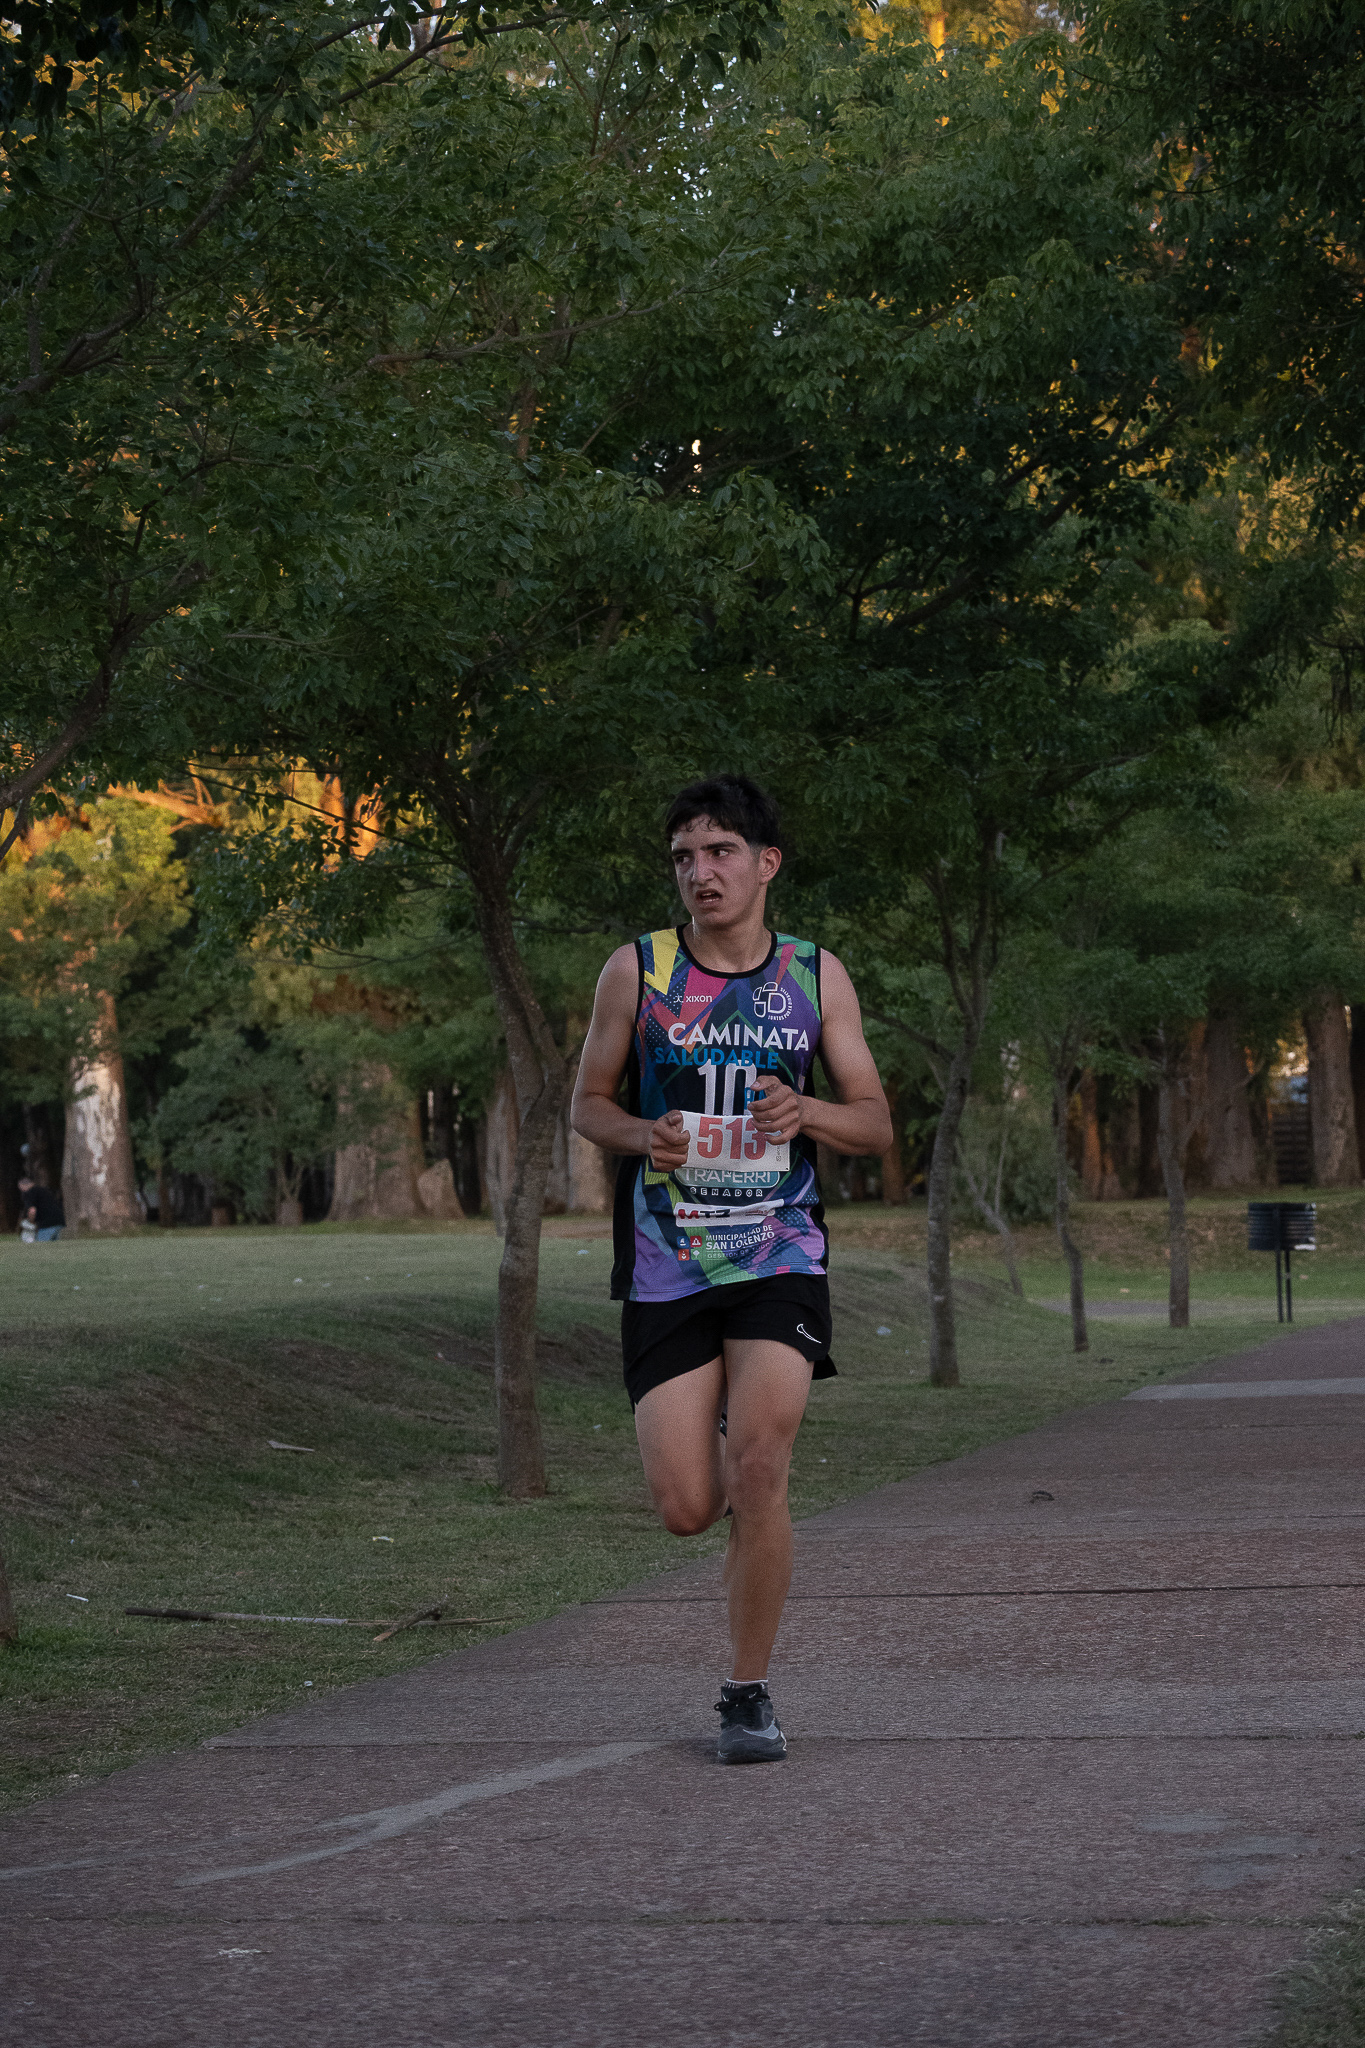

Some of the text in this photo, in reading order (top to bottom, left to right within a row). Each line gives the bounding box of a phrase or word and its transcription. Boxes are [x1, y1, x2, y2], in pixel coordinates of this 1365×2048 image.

[667, 1022, 809, 1051] CAMINATA
[654, 1047, 779, 1069] SALUDABLE
[697, 1116, 767, 1160] 513
[690, 1186, 763, 1198] SENADOR
[762, 1224, 773, 1232] DE
[706, 1241, 728, 1251] SAN
